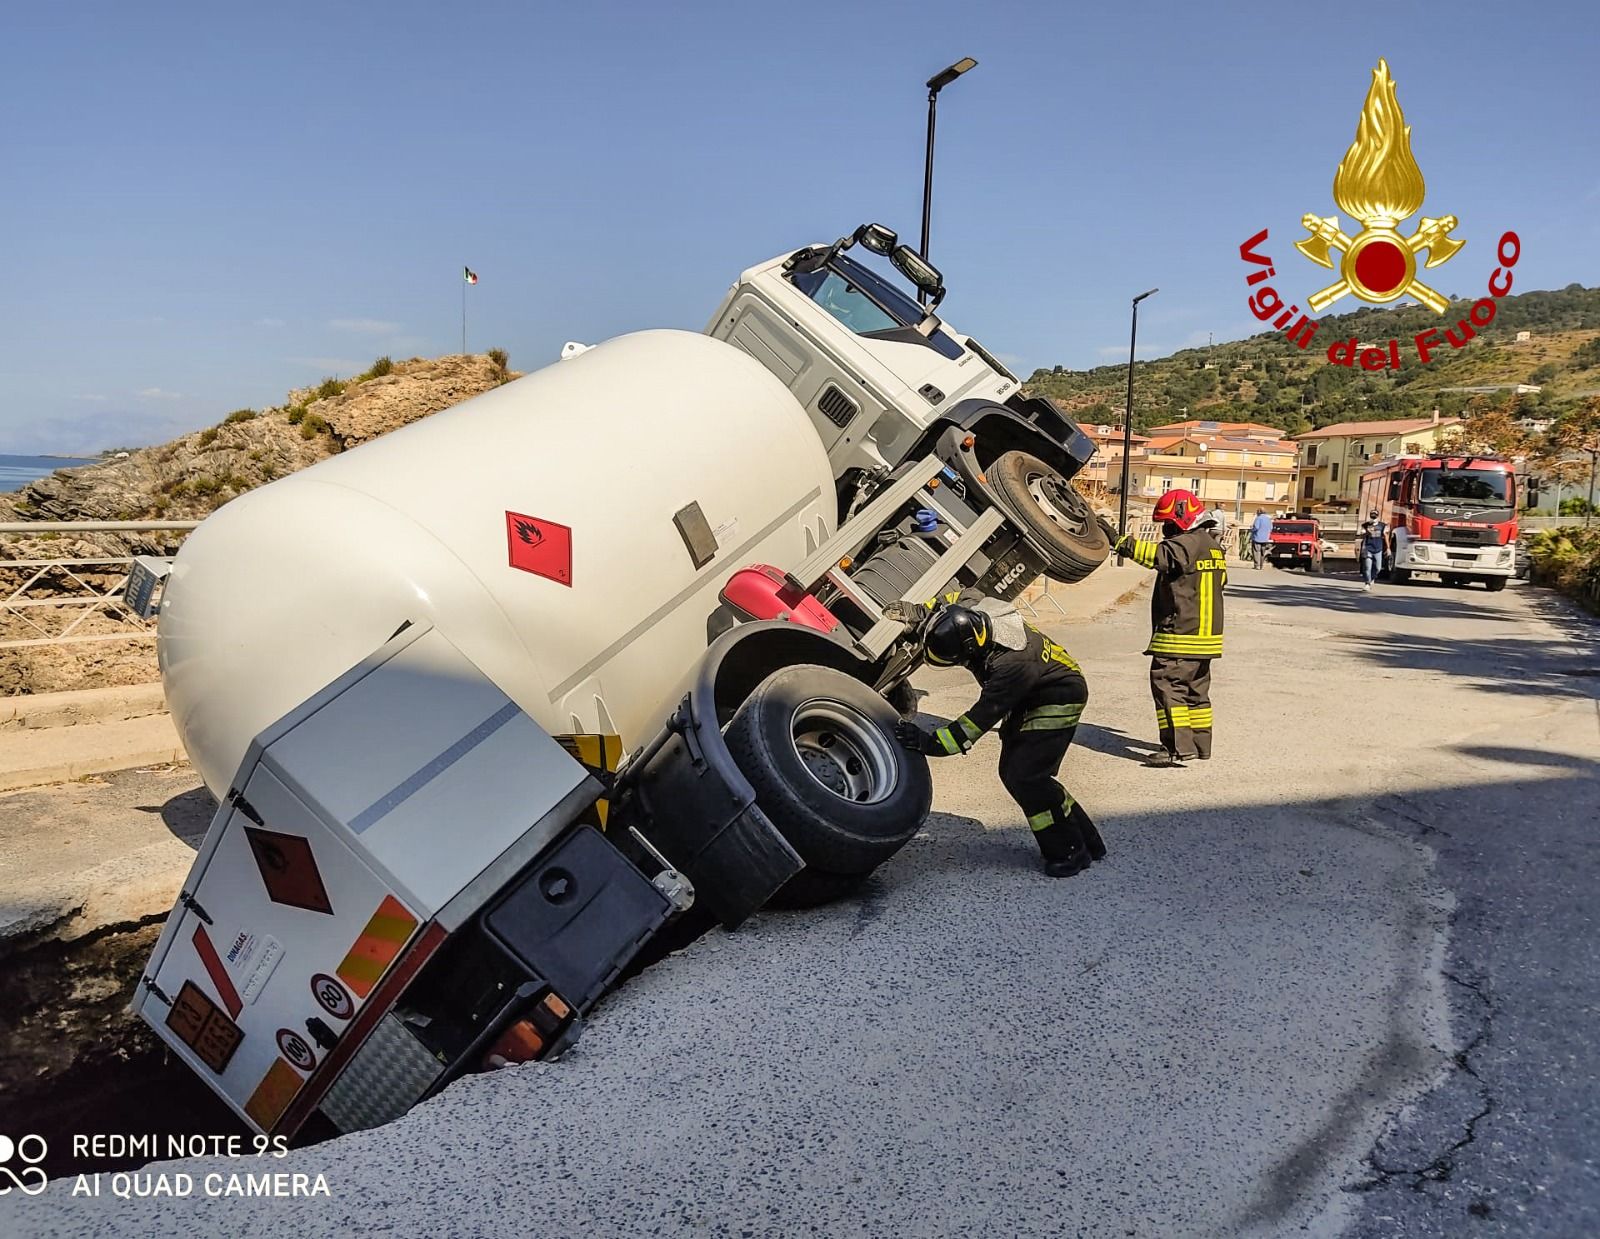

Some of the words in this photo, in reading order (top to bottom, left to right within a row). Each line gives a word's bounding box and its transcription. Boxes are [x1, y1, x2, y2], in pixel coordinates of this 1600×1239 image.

[126, 564, 146, 607] omsp
[994, 562, 1026, 594] IVECO
[226, 932, 248, 963] DINAGAS
[320, 984, 343, 1009] 80
[175, 1000, 203, 1032] 23
[285, 1037, 307, 1062] 100
